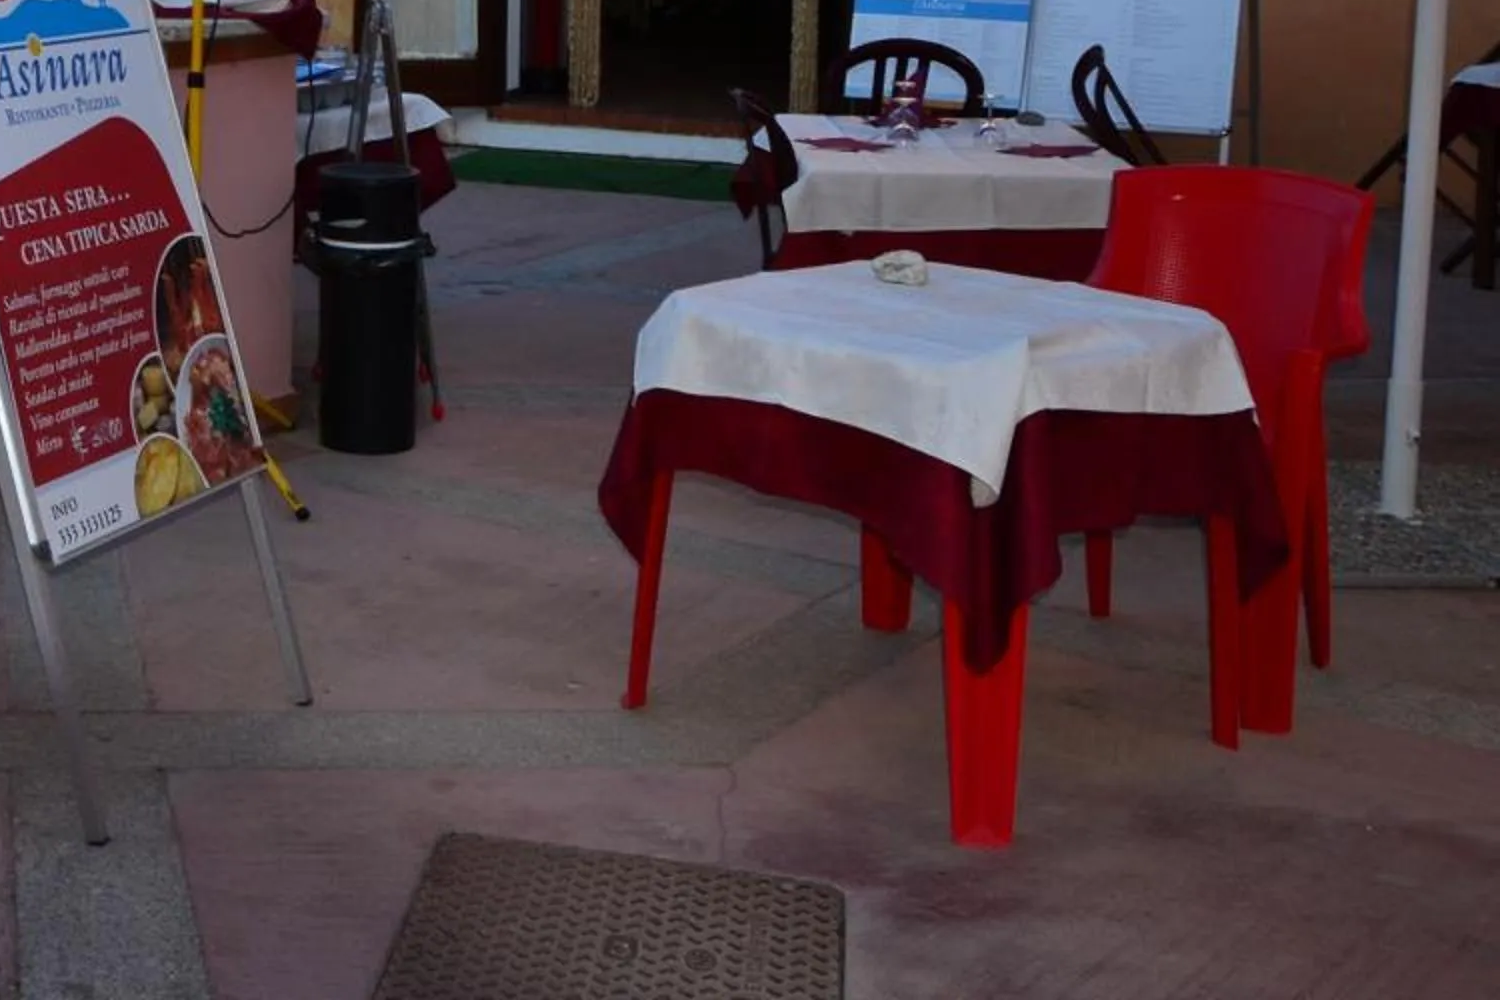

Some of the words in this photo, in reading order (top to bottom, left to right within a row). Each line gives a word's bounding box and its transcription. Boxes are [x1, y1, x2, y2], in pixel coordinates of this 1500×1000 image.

[20, 235, 68, 266] CENA
[66, 221, 119, 254] TIPICA
[120, 208, 170, 240] SARDA
[51, 496, 78, 521] INFO
